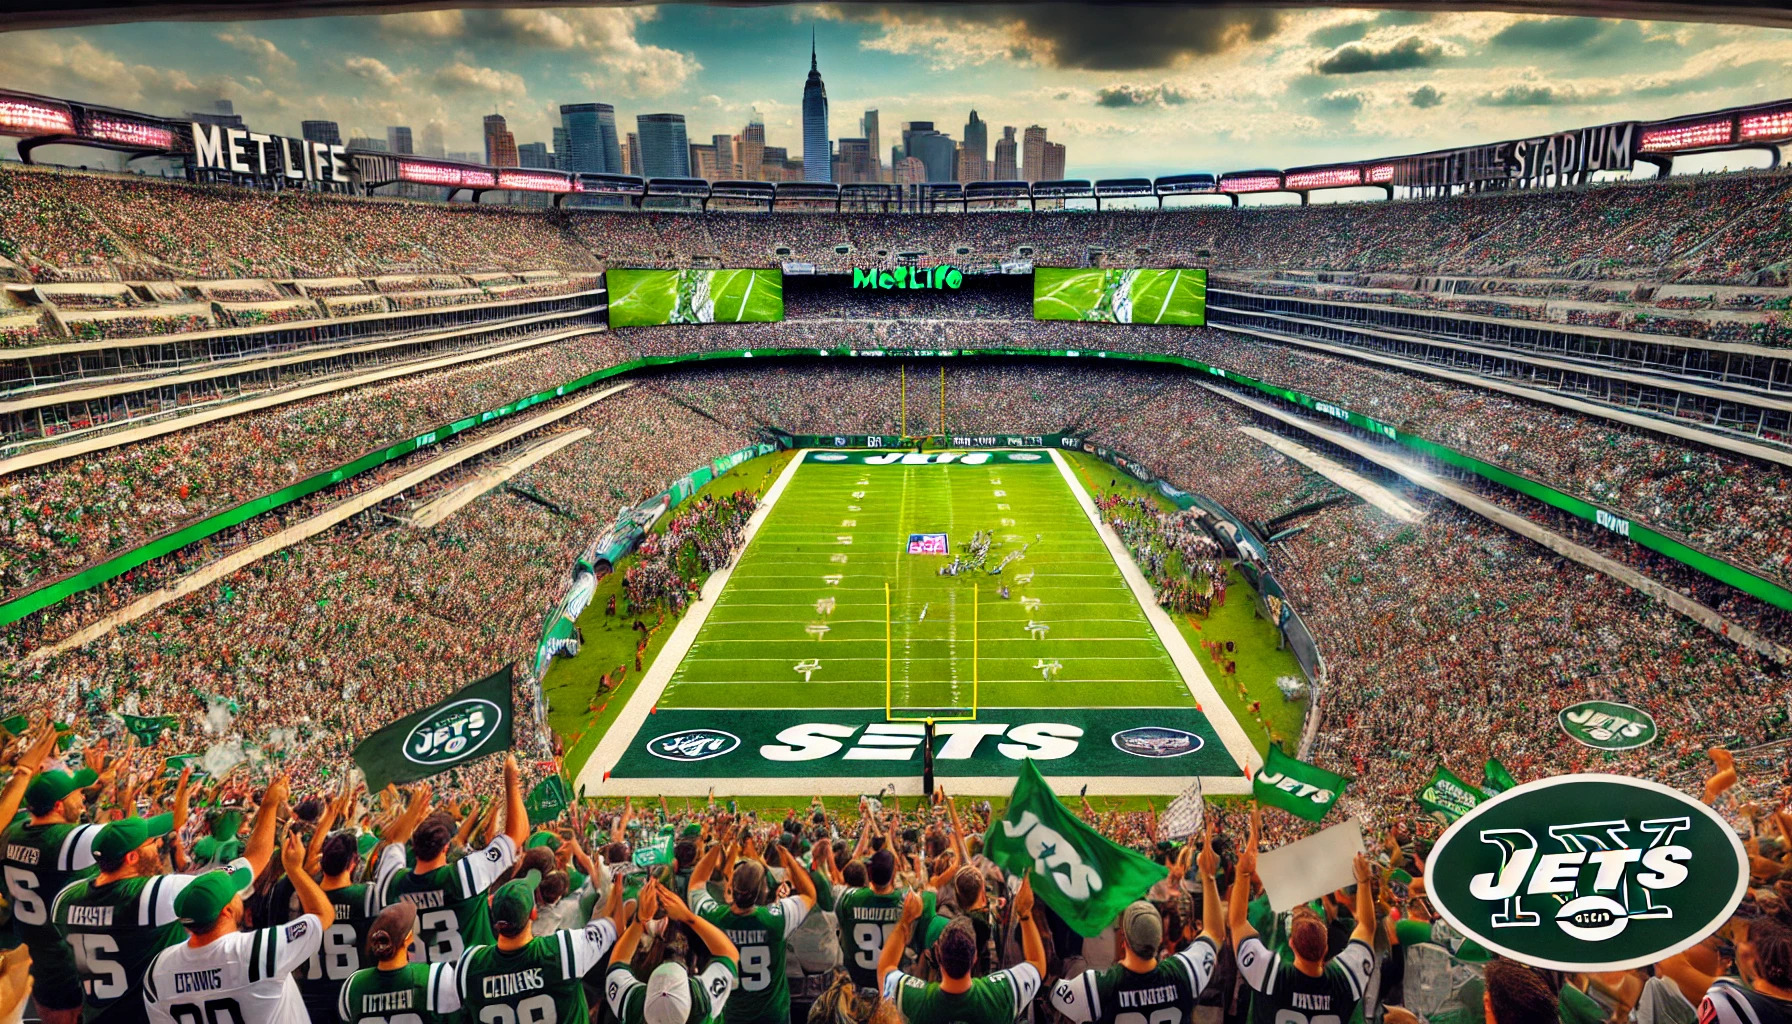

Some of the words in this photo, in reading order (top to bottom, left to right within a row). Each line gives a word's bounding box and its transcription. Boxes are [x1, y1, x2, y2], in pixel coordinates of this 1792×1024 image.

[192, 121, 271, 175] MET
[281, 137, 350, 182] LIFE
[1513, 123, 1634, 178] STADIUM
